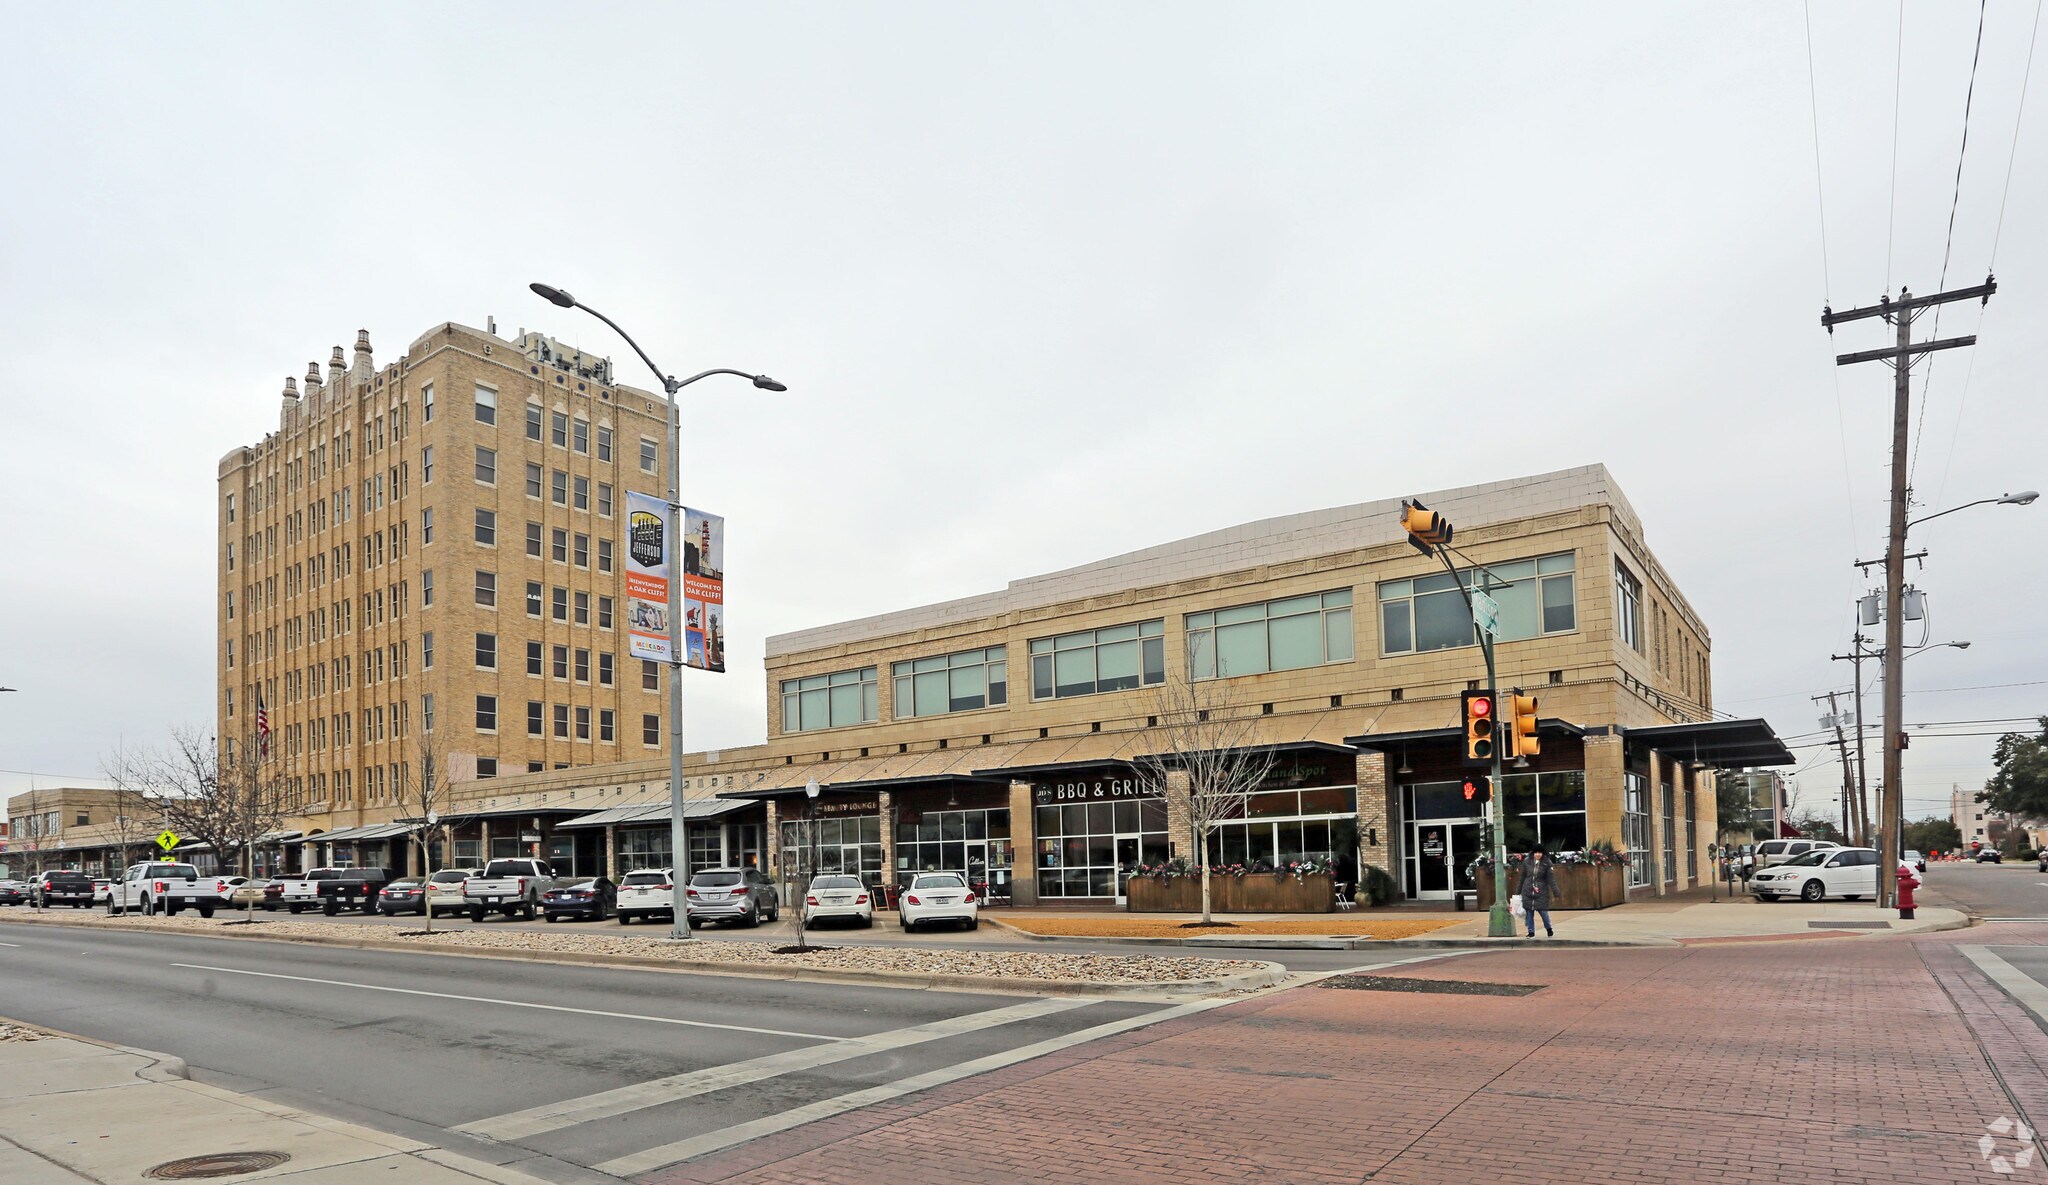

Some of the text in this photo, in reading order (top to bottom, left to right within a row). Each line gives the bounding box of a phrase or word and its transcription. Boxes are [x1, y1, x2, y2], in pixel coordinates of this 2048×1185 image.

[633, 541, 660, 558] JEFFERSON
[634, 585, 647, 594] OAK
[647, 588, 665, 597] CLIFF!
[685, 579, 712, 590] WELCOME
[686, 586, 721, 600] OAK CLIFF!
[1299, 764, 1328, 781] Spot
[1057, 778, 1160, 799] BBQ & GRILL
[823, 802, 876, 812] BEAUTY LOUNGE
